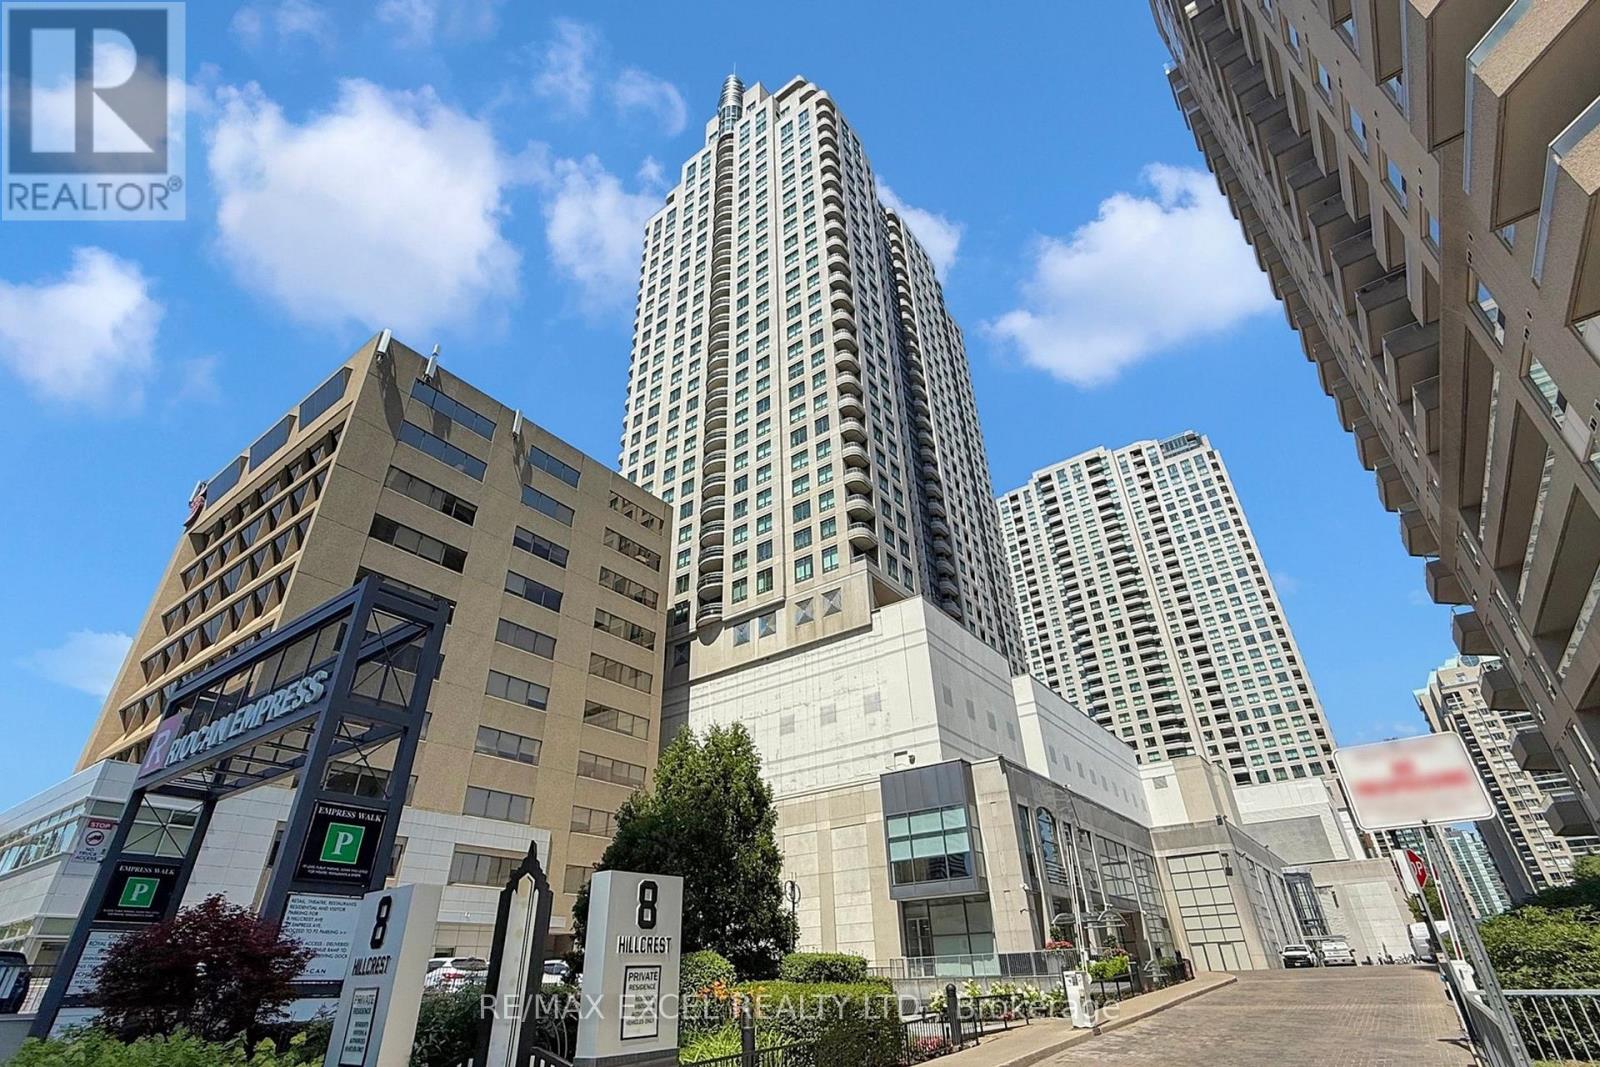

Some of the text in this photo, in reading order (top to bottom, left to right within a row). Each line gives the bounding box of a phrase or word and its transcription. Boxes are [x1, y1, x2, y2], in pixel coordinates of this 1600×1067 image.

[228, 670, 328, 738] EMPRESS
[318, 806, 382, 822] EMPRESS WALK
[89, 821, 112, 830] STOP
[331, 831, 354, 855] P
[119, 865, 175, 875] EMPRESS WALK
[129, 883, 149, 901] P
[637, 879, 659, 930] 8
[369, 895, 392, 949] 8
[617, 935, 672, 955] HILLCREST
[352, 955, 391, 976] HILLCREST
[628, 971, 658, 981] PRIVATE
[628, 983, 656, 991] RESIDENCE
